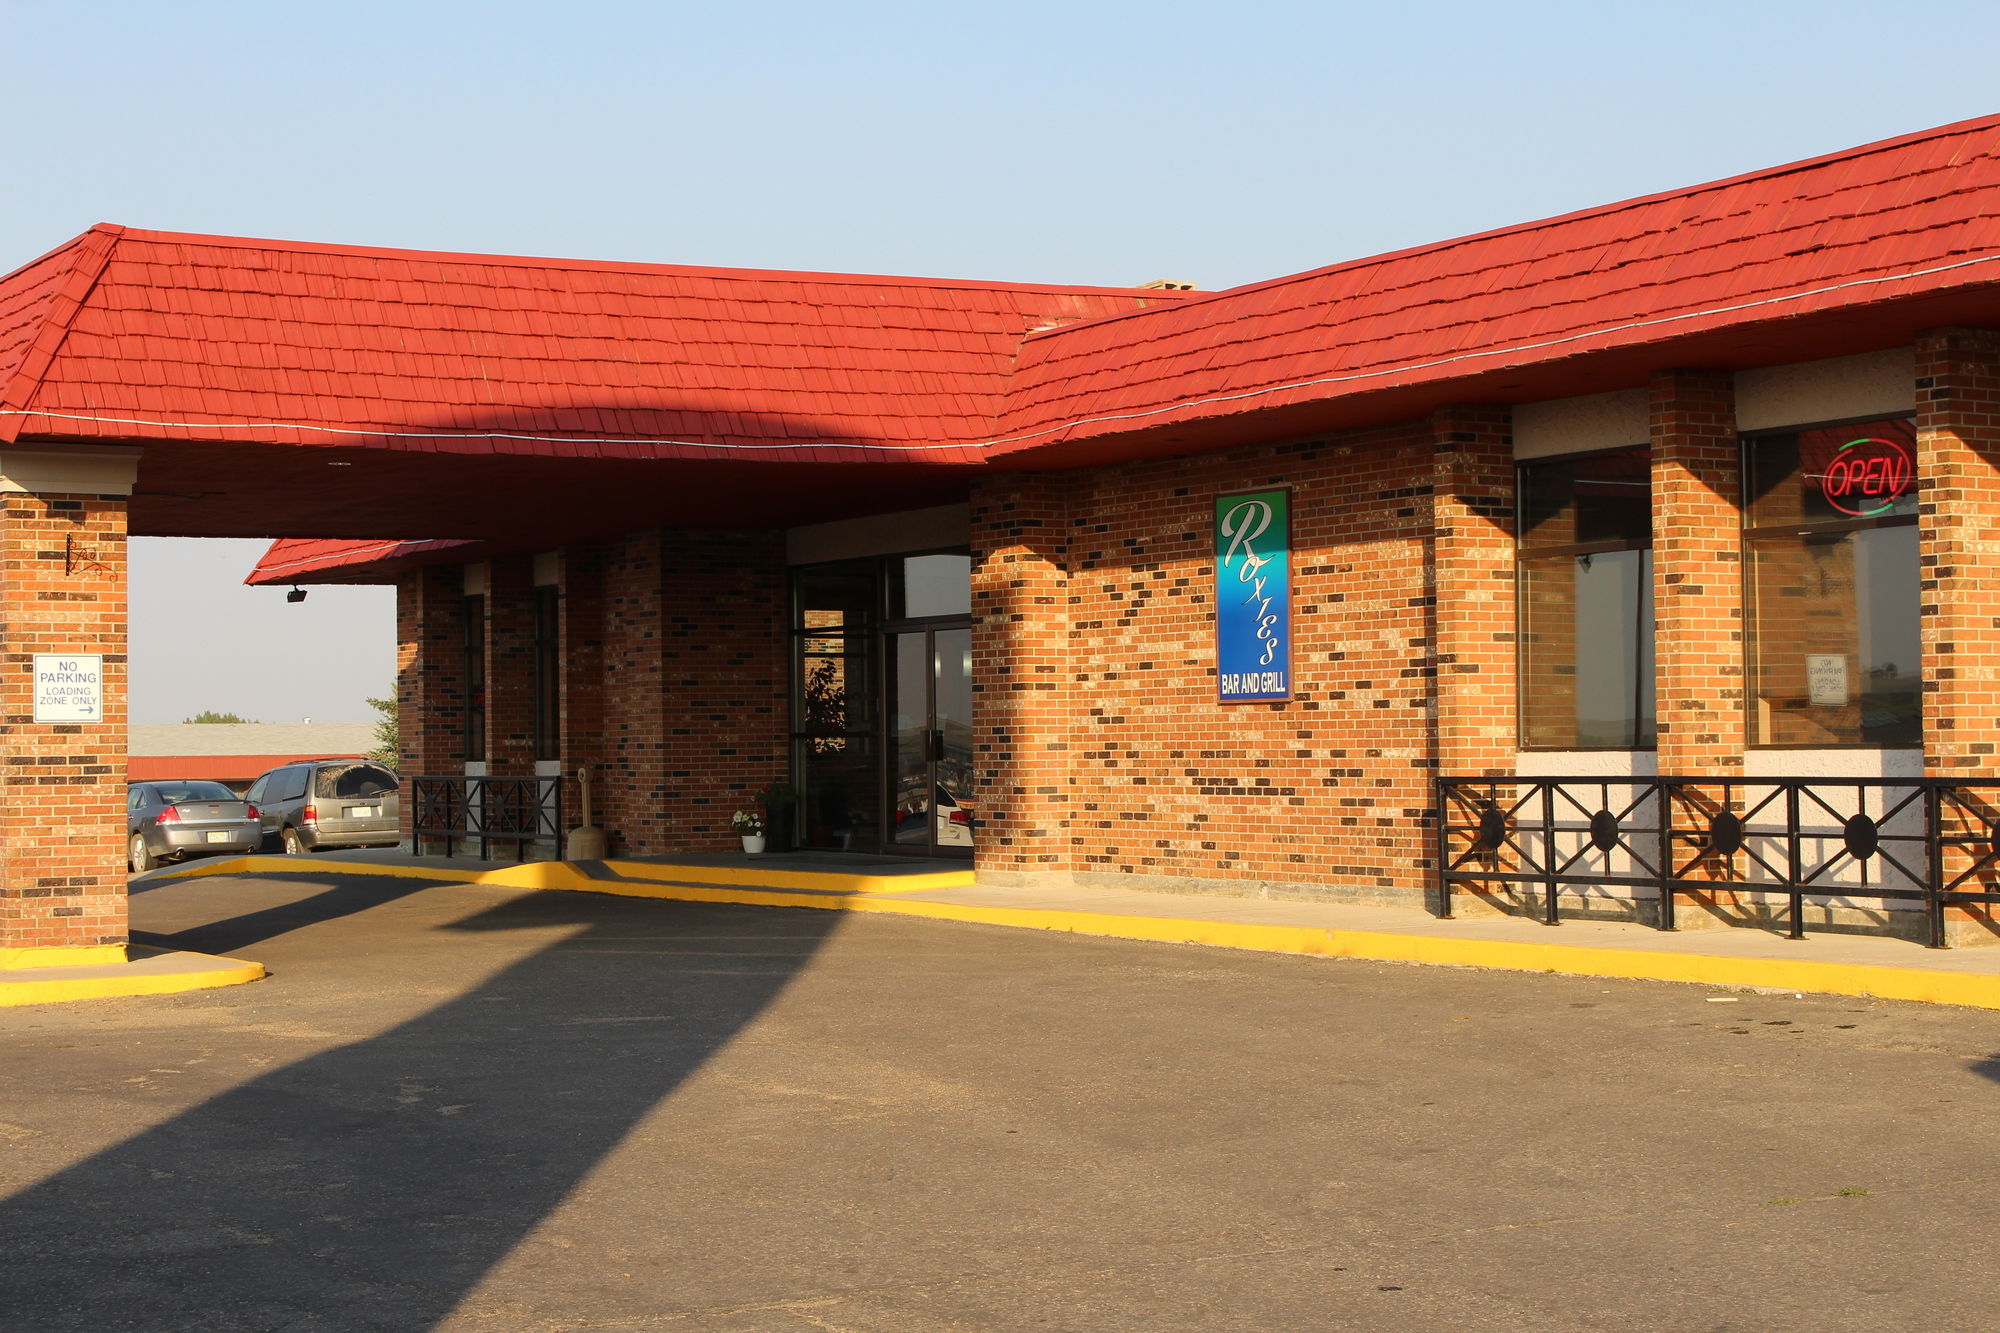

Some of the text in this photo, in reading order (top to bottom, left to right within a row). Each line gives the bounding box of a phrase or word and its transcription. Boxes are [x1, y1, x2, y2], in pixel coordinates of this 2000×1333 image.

[1827, 456, 1903, 496] OPEN
[59, 661, 78, 672] NO
[40, 672, 97, 683] PARKING
[1221, 671, 1286, 695] BAR AND GRILL
[46, 687, 91, 696] LOADING
[40, 696, 97, 705] ZONE ONLY
